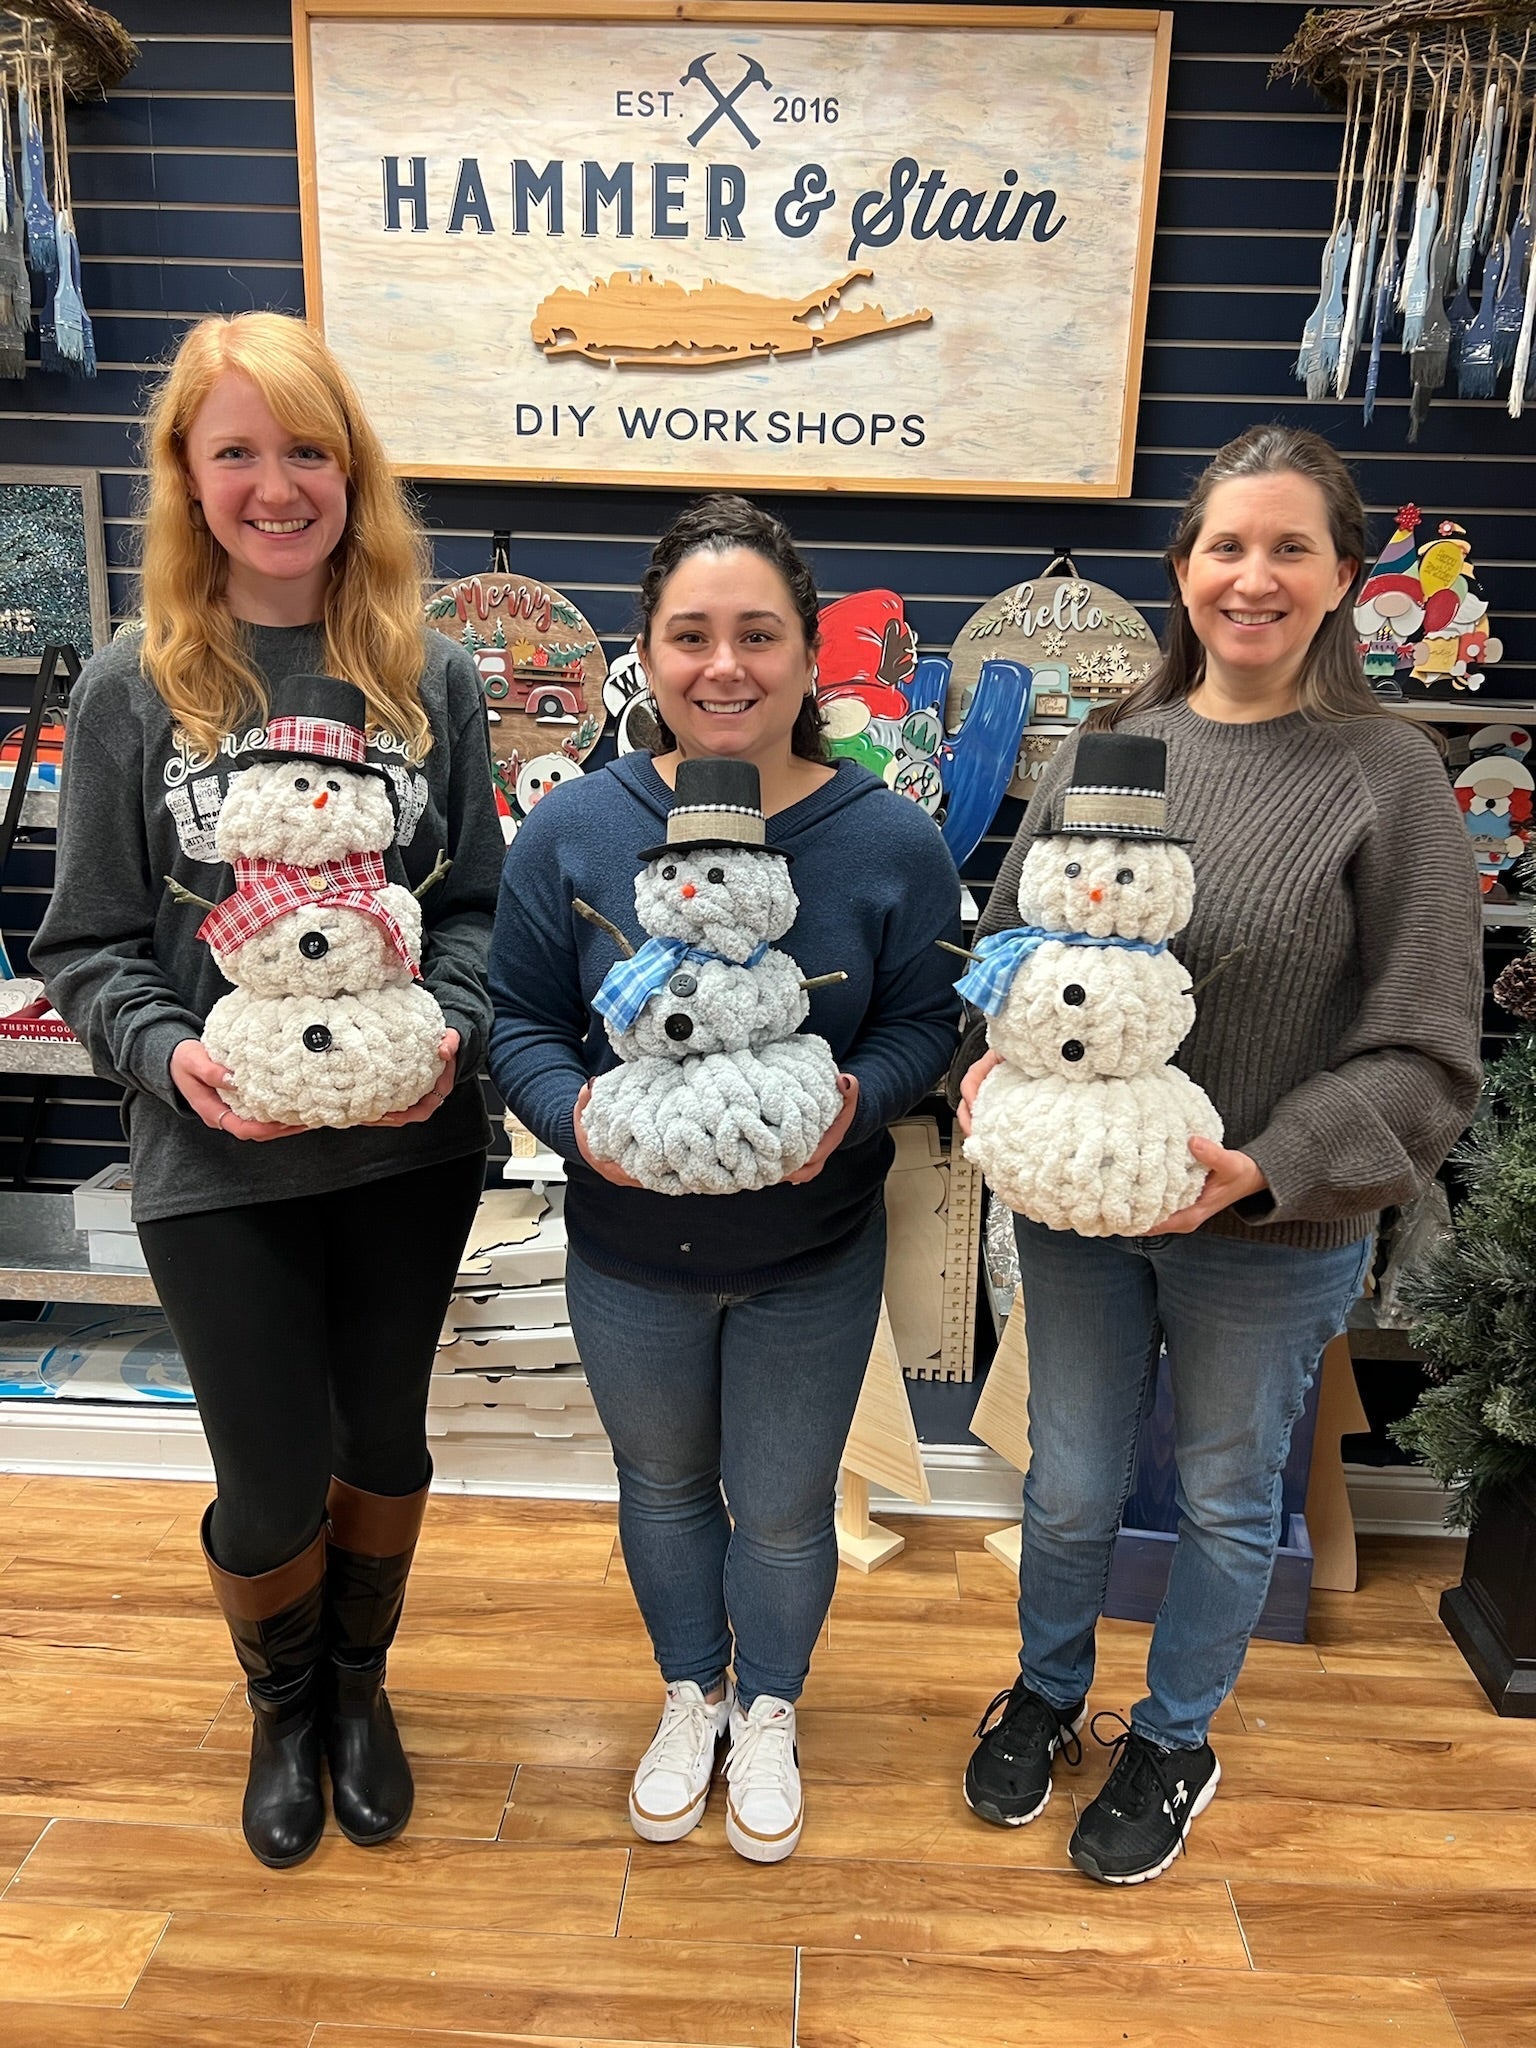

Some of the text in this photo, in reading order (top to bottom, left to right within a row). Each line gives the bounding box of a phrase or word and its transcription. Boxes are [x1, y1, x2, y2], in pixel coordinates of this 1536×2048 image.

[616, 91, 840, 125] EST. 2016
[381, 156, 1067, 262] HAMMER & Stain
[516, 403, 926, 448] DIY WORKSHOPS
[451, 576, 552, 632] Merry
[1013, 582, 1104, 638] hello
[50, 1025, 72, 1033] GOO
